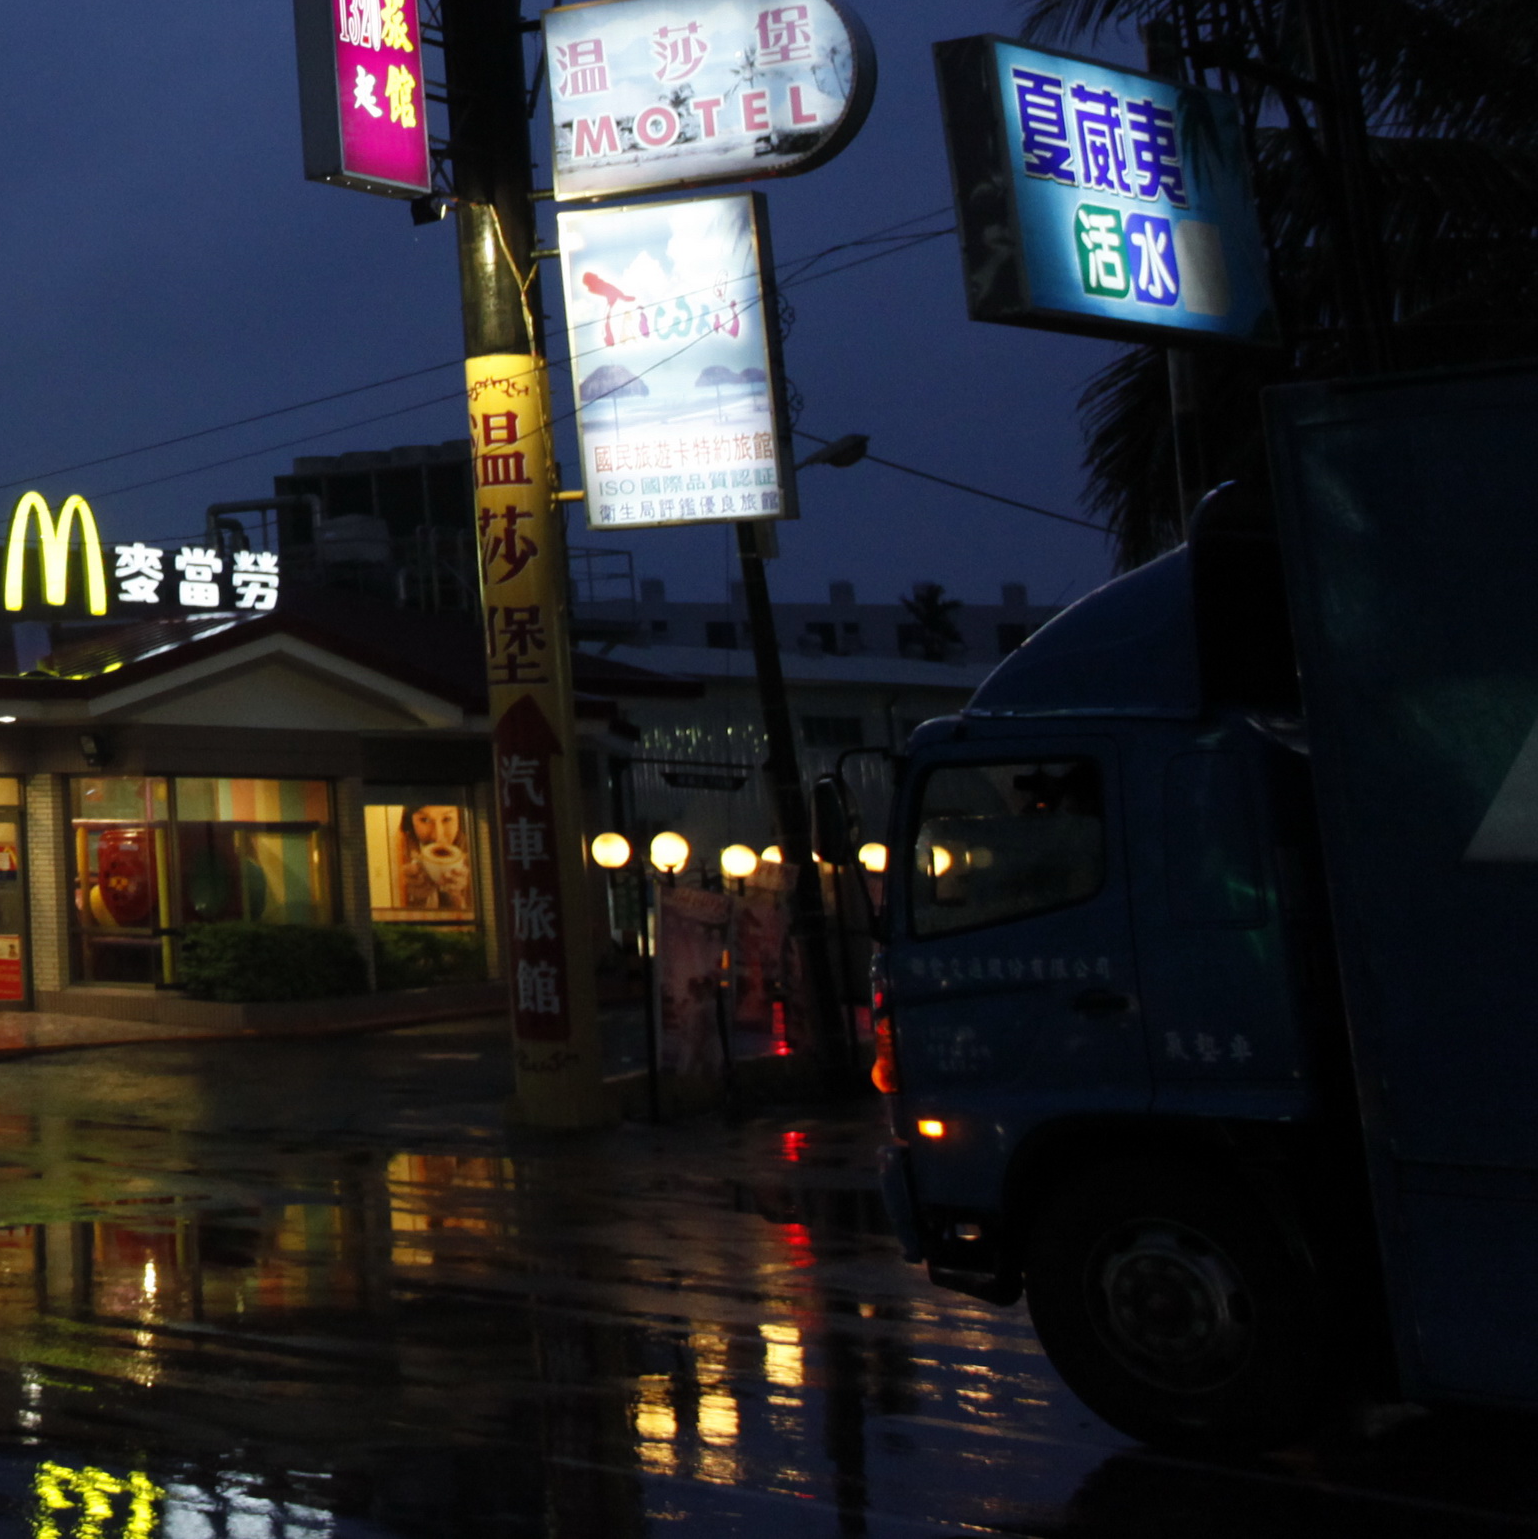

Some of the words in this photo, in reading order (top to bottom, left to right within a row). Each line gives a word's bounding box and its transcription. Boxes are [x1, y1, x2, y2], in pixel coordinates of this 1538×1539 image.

[572, 84, 818, 159] MOTEL
[1077, 209, 1176, 299] 活水
[594, 431, 773, 474] 國民旅遊卡特約旅館
[598, 478, 636, 497] ISO
[598, 490, 781, 523] 衛生局評鑑優良旅館
[114, 542, 280, 612] 麥當勞
[500, 754, 562, 1016] 汽車旅館
